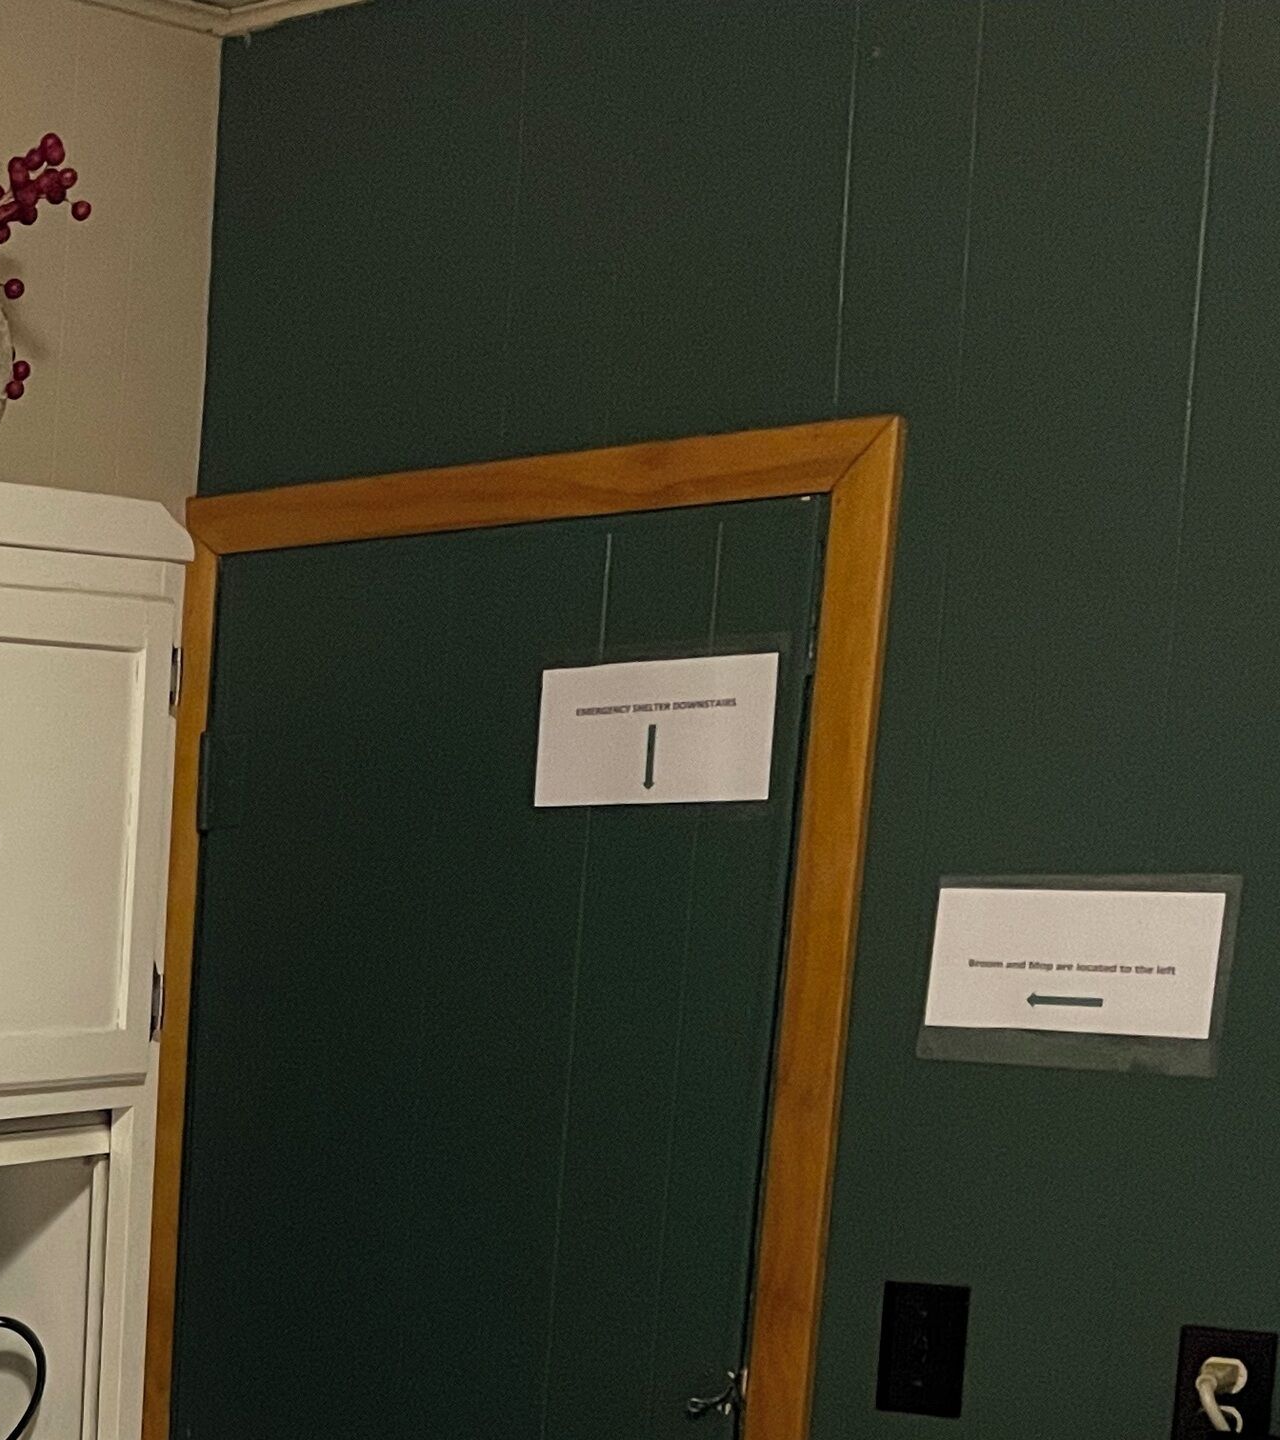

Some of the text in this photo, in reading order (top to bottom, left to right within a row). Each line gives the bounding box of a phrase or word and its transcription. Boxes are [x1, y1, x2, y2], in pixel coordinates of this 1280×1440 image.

[576, 698, 737, 716] EMERGENCY SHELTER DOWNSTAIRS
[968, 959, 1003, 968] Broom
[1006, 961, 1026, 969] and
[1028, 961, 1053, 971] Mop
[1076, 963, 1117, 973] located
[1119, 965, 1132, 973] to
[1134, 965, 1154, 974] the
[1156, 964, 1176, 975] left
